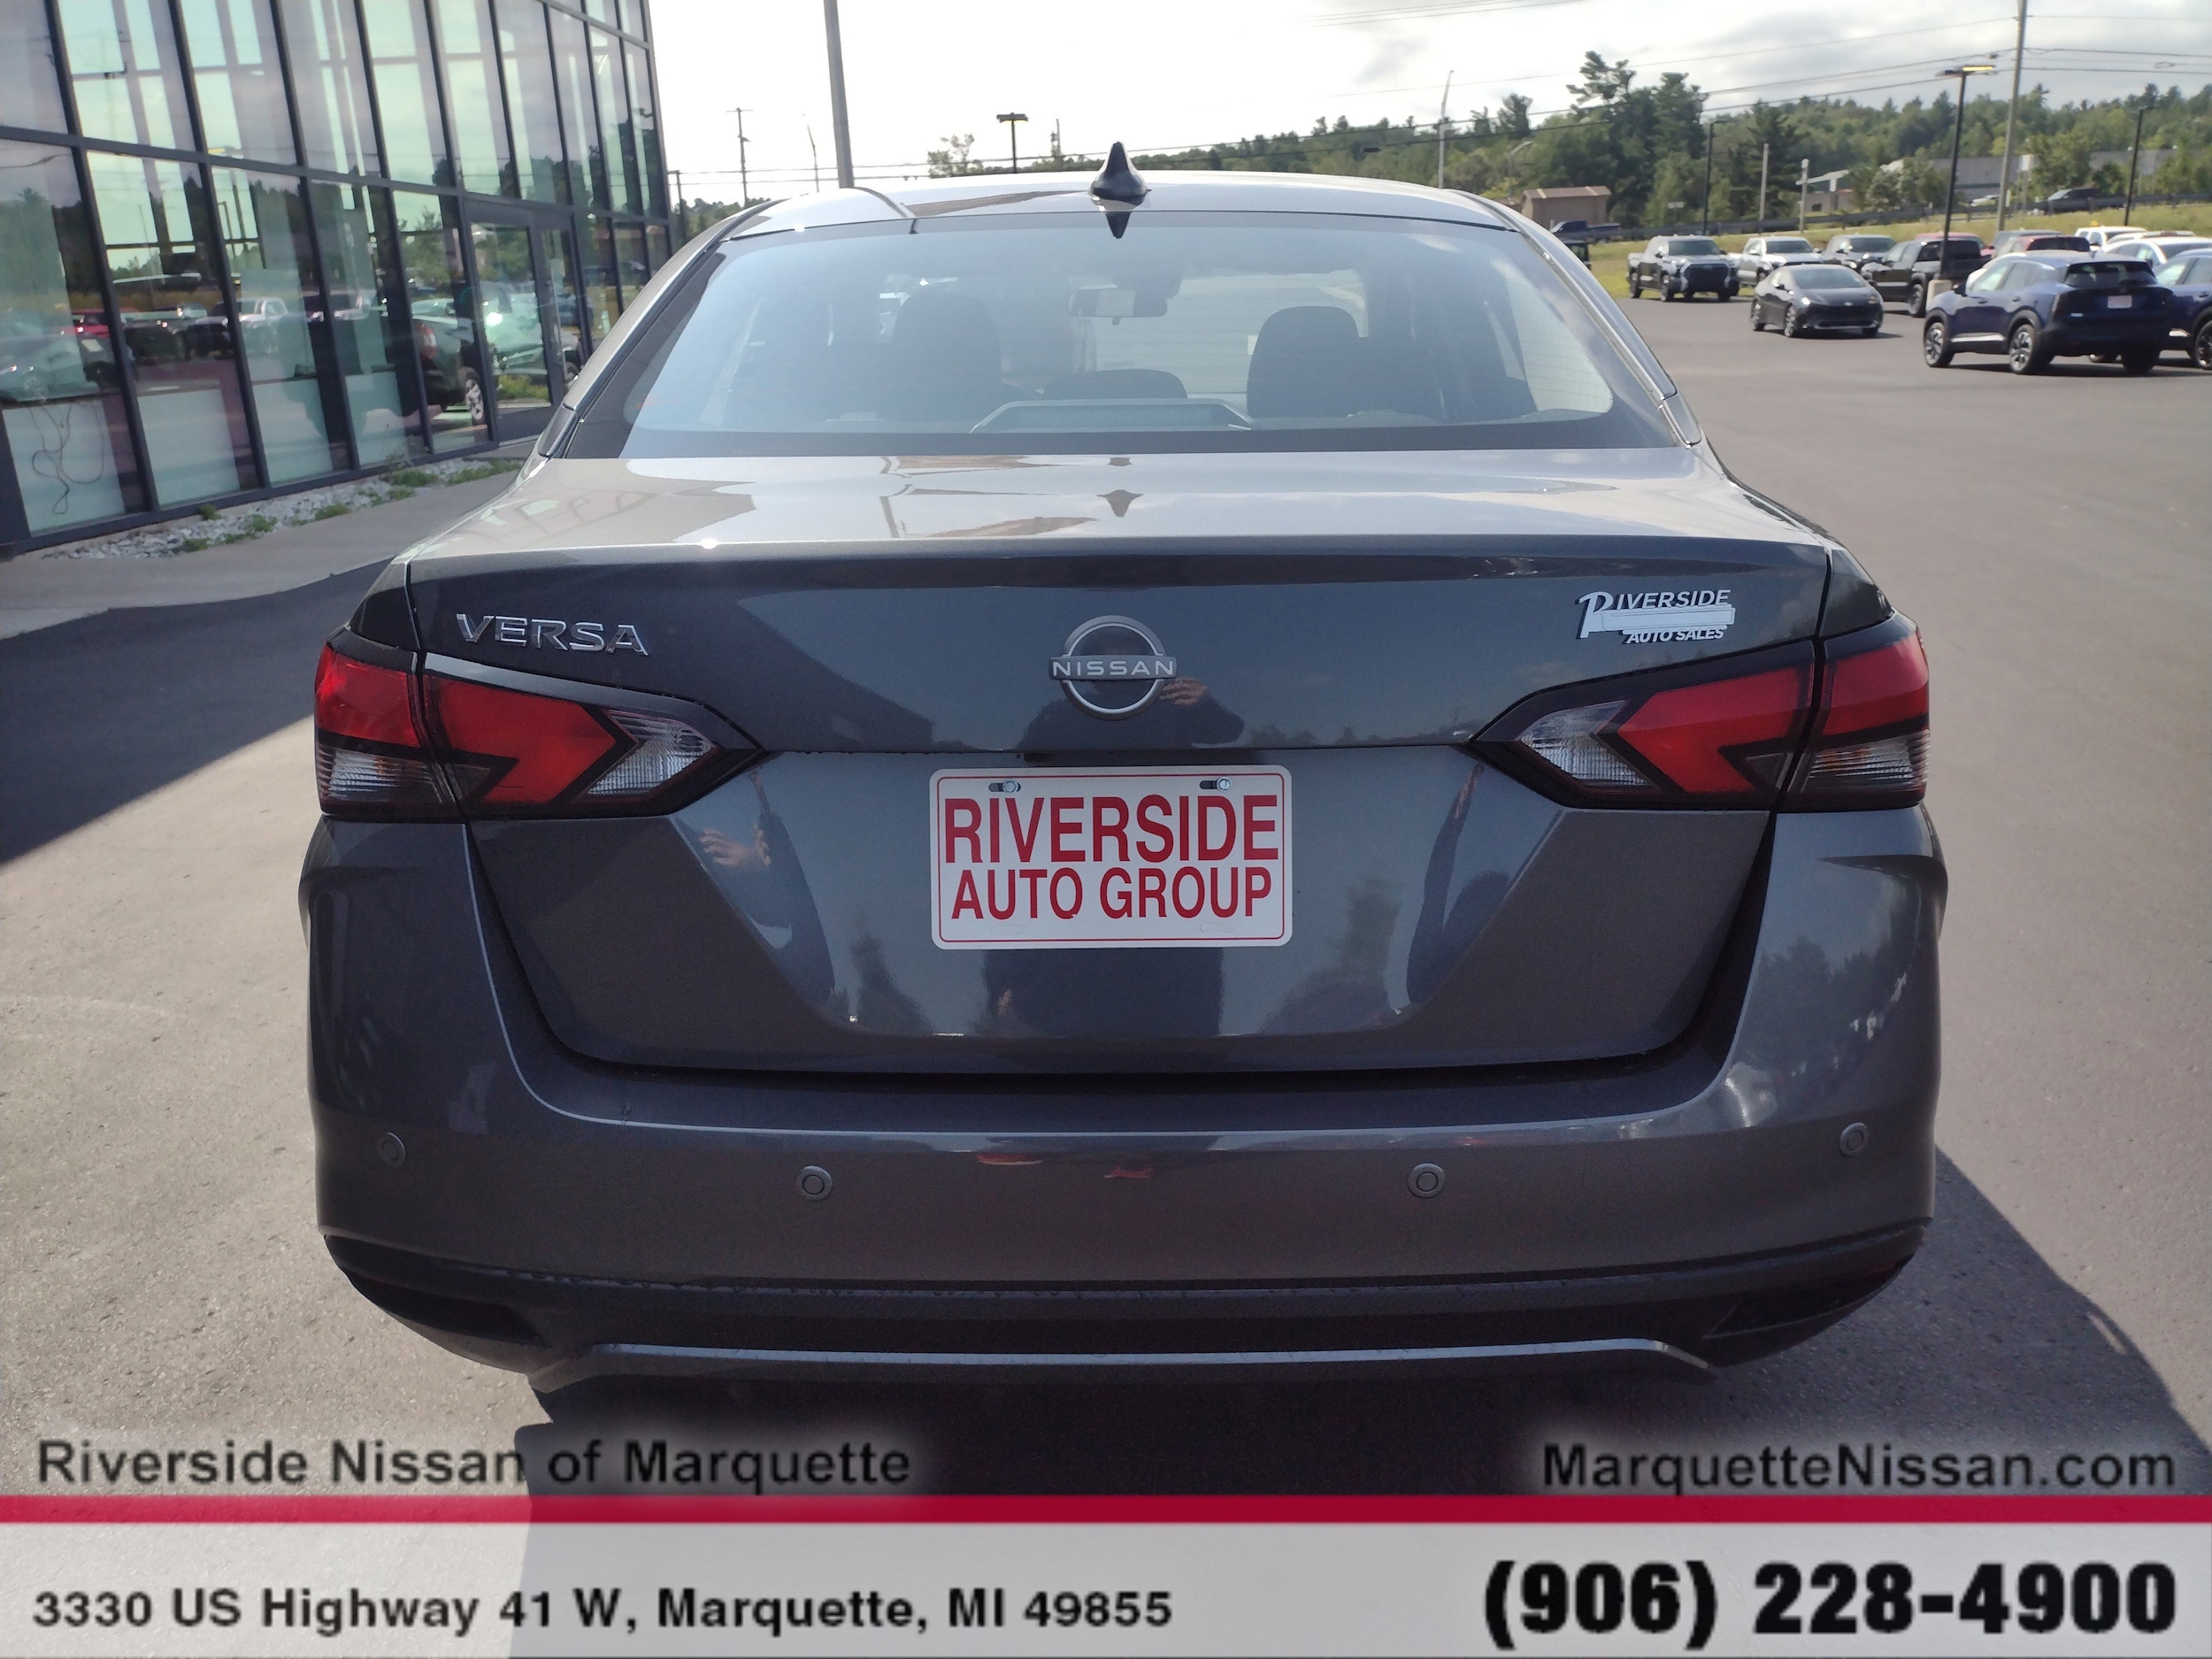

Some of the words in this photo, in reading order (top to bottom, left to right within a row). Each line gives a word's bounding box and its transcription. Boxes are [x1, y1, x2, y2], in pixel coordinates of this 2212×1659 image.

[456, 613, 649, 657] VERSA
[1577, 589, 1732, 639] RIVERSIDE
[1625, 630, 1673, 644] AUTO
[1675, 628, 1724, 641] SALES
[1052, 660, 1173, 677] NISSAN
[944, 794, 1279, 864] RIVERSIDE
[951, 867, 1083, 920] AUTO
[1099, 866, 1272, 919] GROUP
